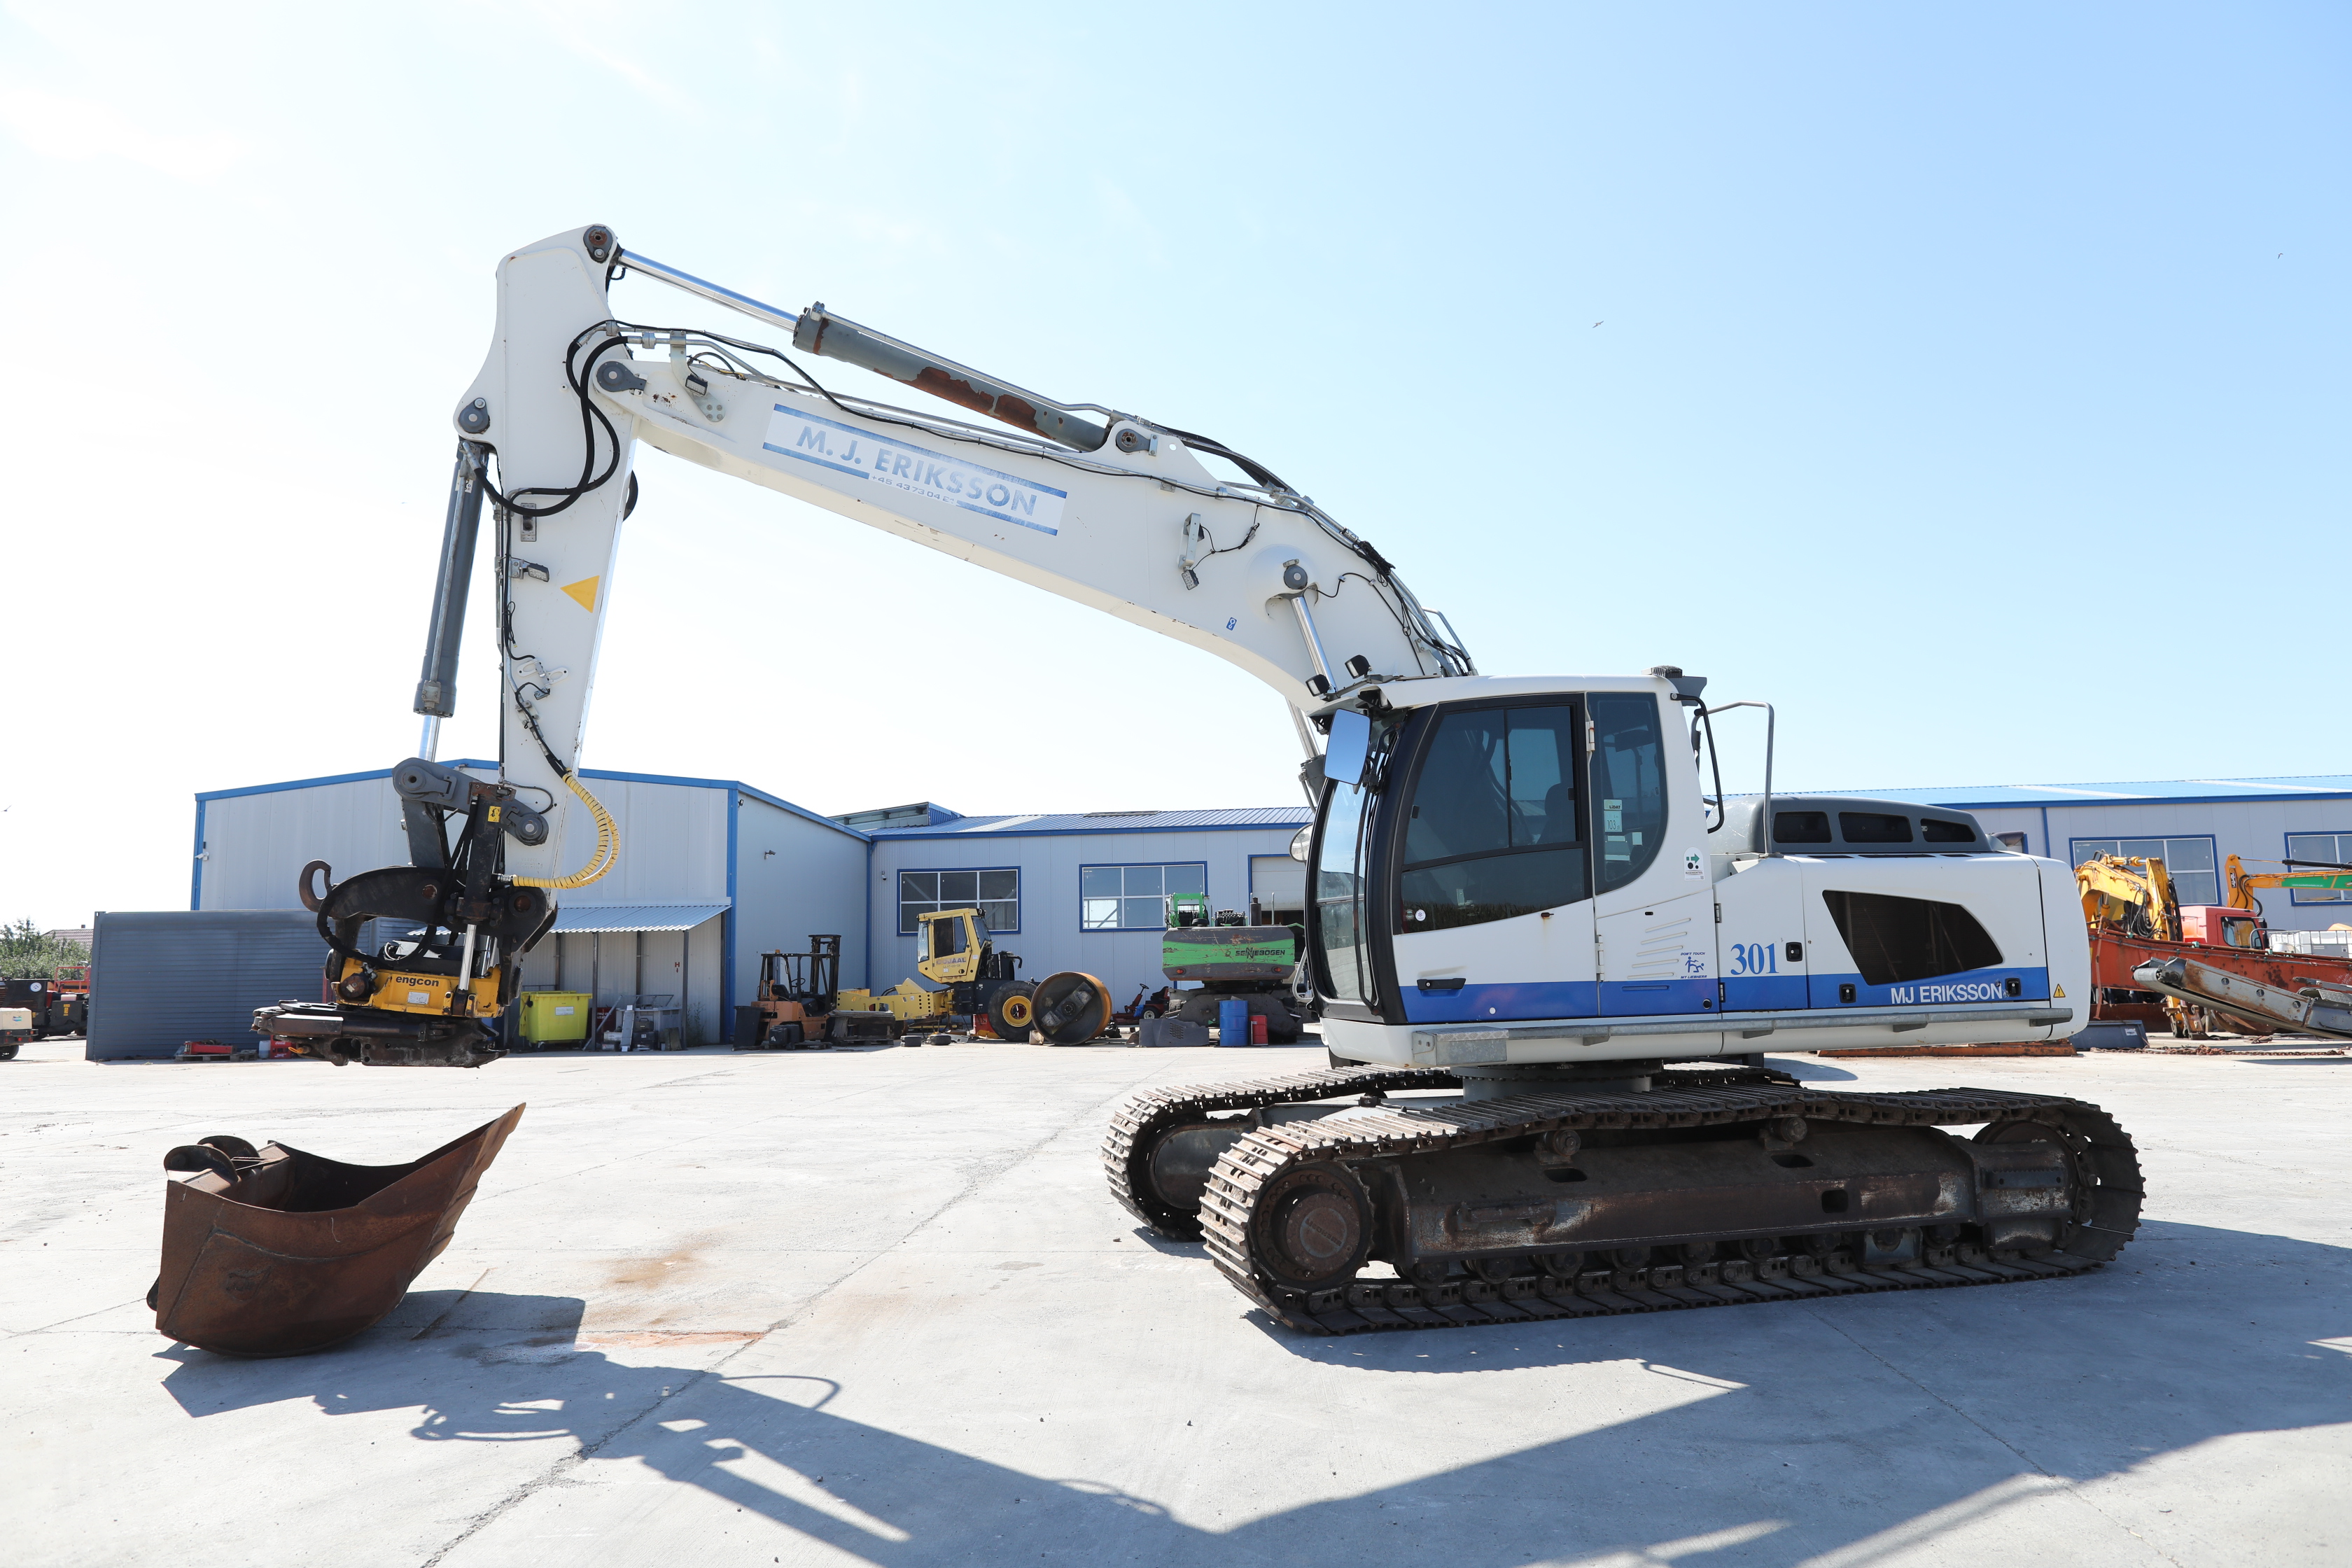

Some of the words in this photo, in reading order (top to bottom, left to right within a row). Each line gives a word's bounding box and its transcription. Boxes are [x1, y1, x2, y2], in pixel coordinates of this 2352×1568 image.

[796, 426, 833, 456] M.
[840, 440, 862, 465] J.
[874, 448, 1037, 516] ERIKSSON
[872, 476, 892, 485] +45
[1607, 820, 1616, 830] 103
[1236, 947, 1285, 958] SENNEBOGEN
[1730, 943, 1779, 975] 301
[396, 976, 439, 986] engcon
[1891, 986, 1914, 1004] MJ
[1919, 983, 2003, 1002] ERIKSSON
